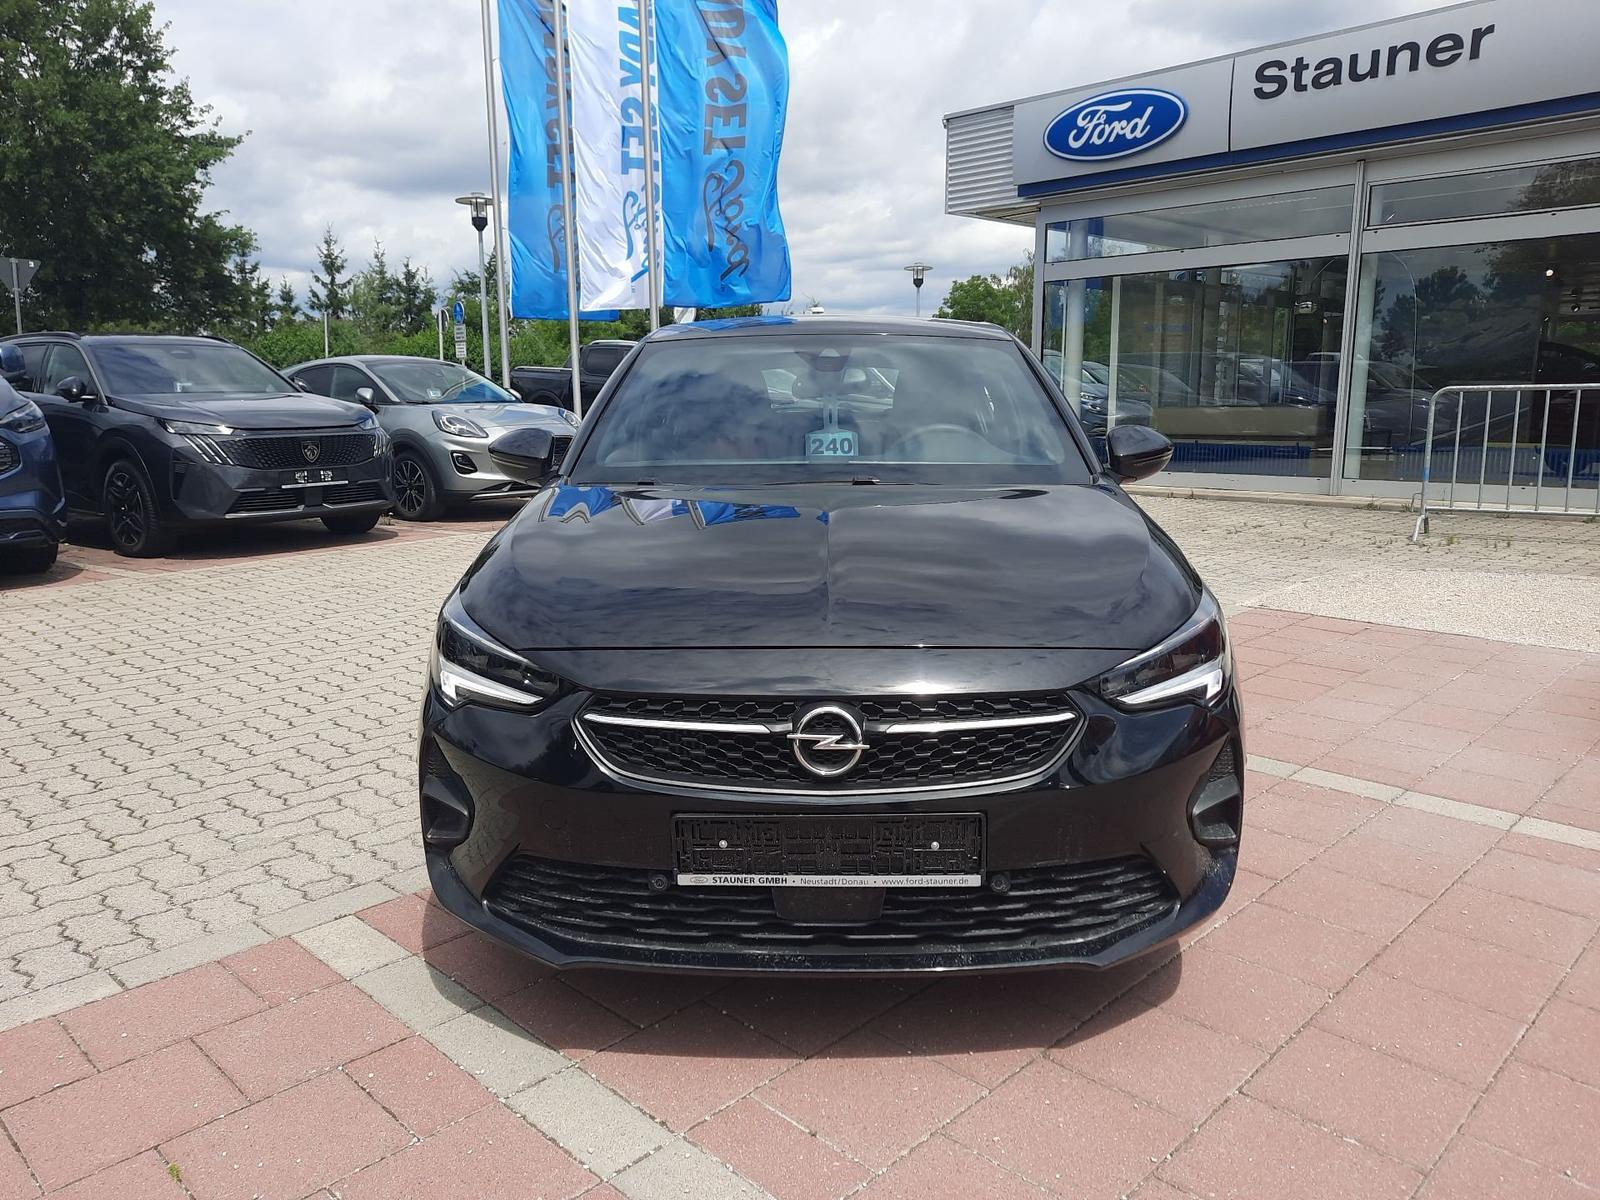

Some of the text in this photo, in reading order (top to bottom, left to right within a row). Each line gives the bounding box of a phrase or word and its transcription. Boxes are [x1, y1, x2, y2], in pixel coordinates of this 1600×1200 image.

[1254, 23, 1496, 100] Stauner
[1068, 100, 1154, 149] Ford
[811, 437, 853, 455] 240
[711, 876, 756, 885] STAUNER
[758, 876, 788, 885] GMBH
[800, 876, 869, 886] Neustadt/Donau
[881, 876, 969, 886] www.ford-stauner.de
